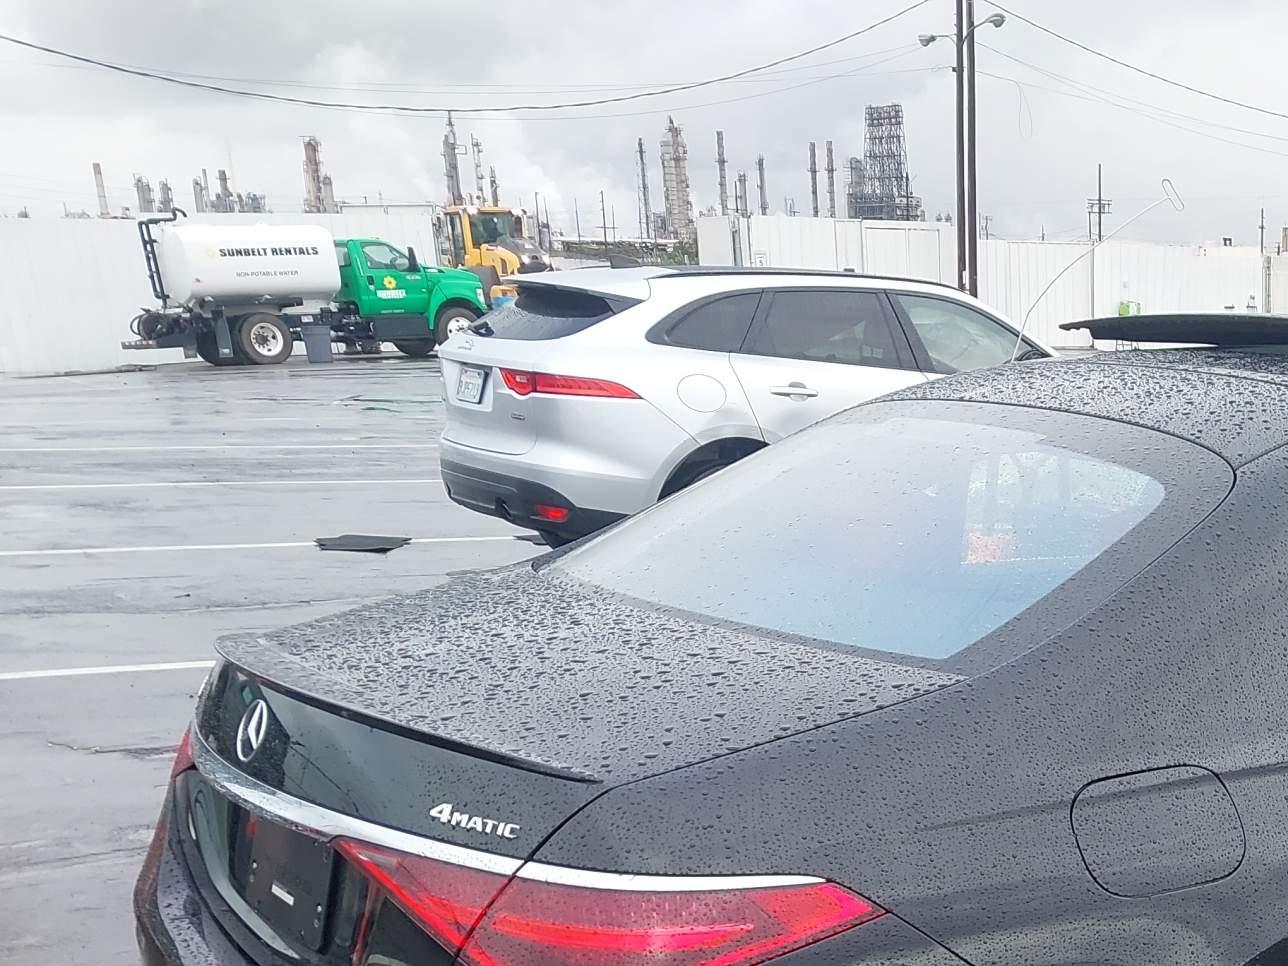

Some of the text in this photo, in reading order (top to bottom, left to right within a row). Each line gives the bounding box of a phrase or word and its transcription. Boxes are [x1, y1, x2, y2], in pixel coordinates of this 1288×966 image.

[219, 247, 319, 257] SUNBELT RENTALS
[429, 803, 521, 839] 4MATIC
